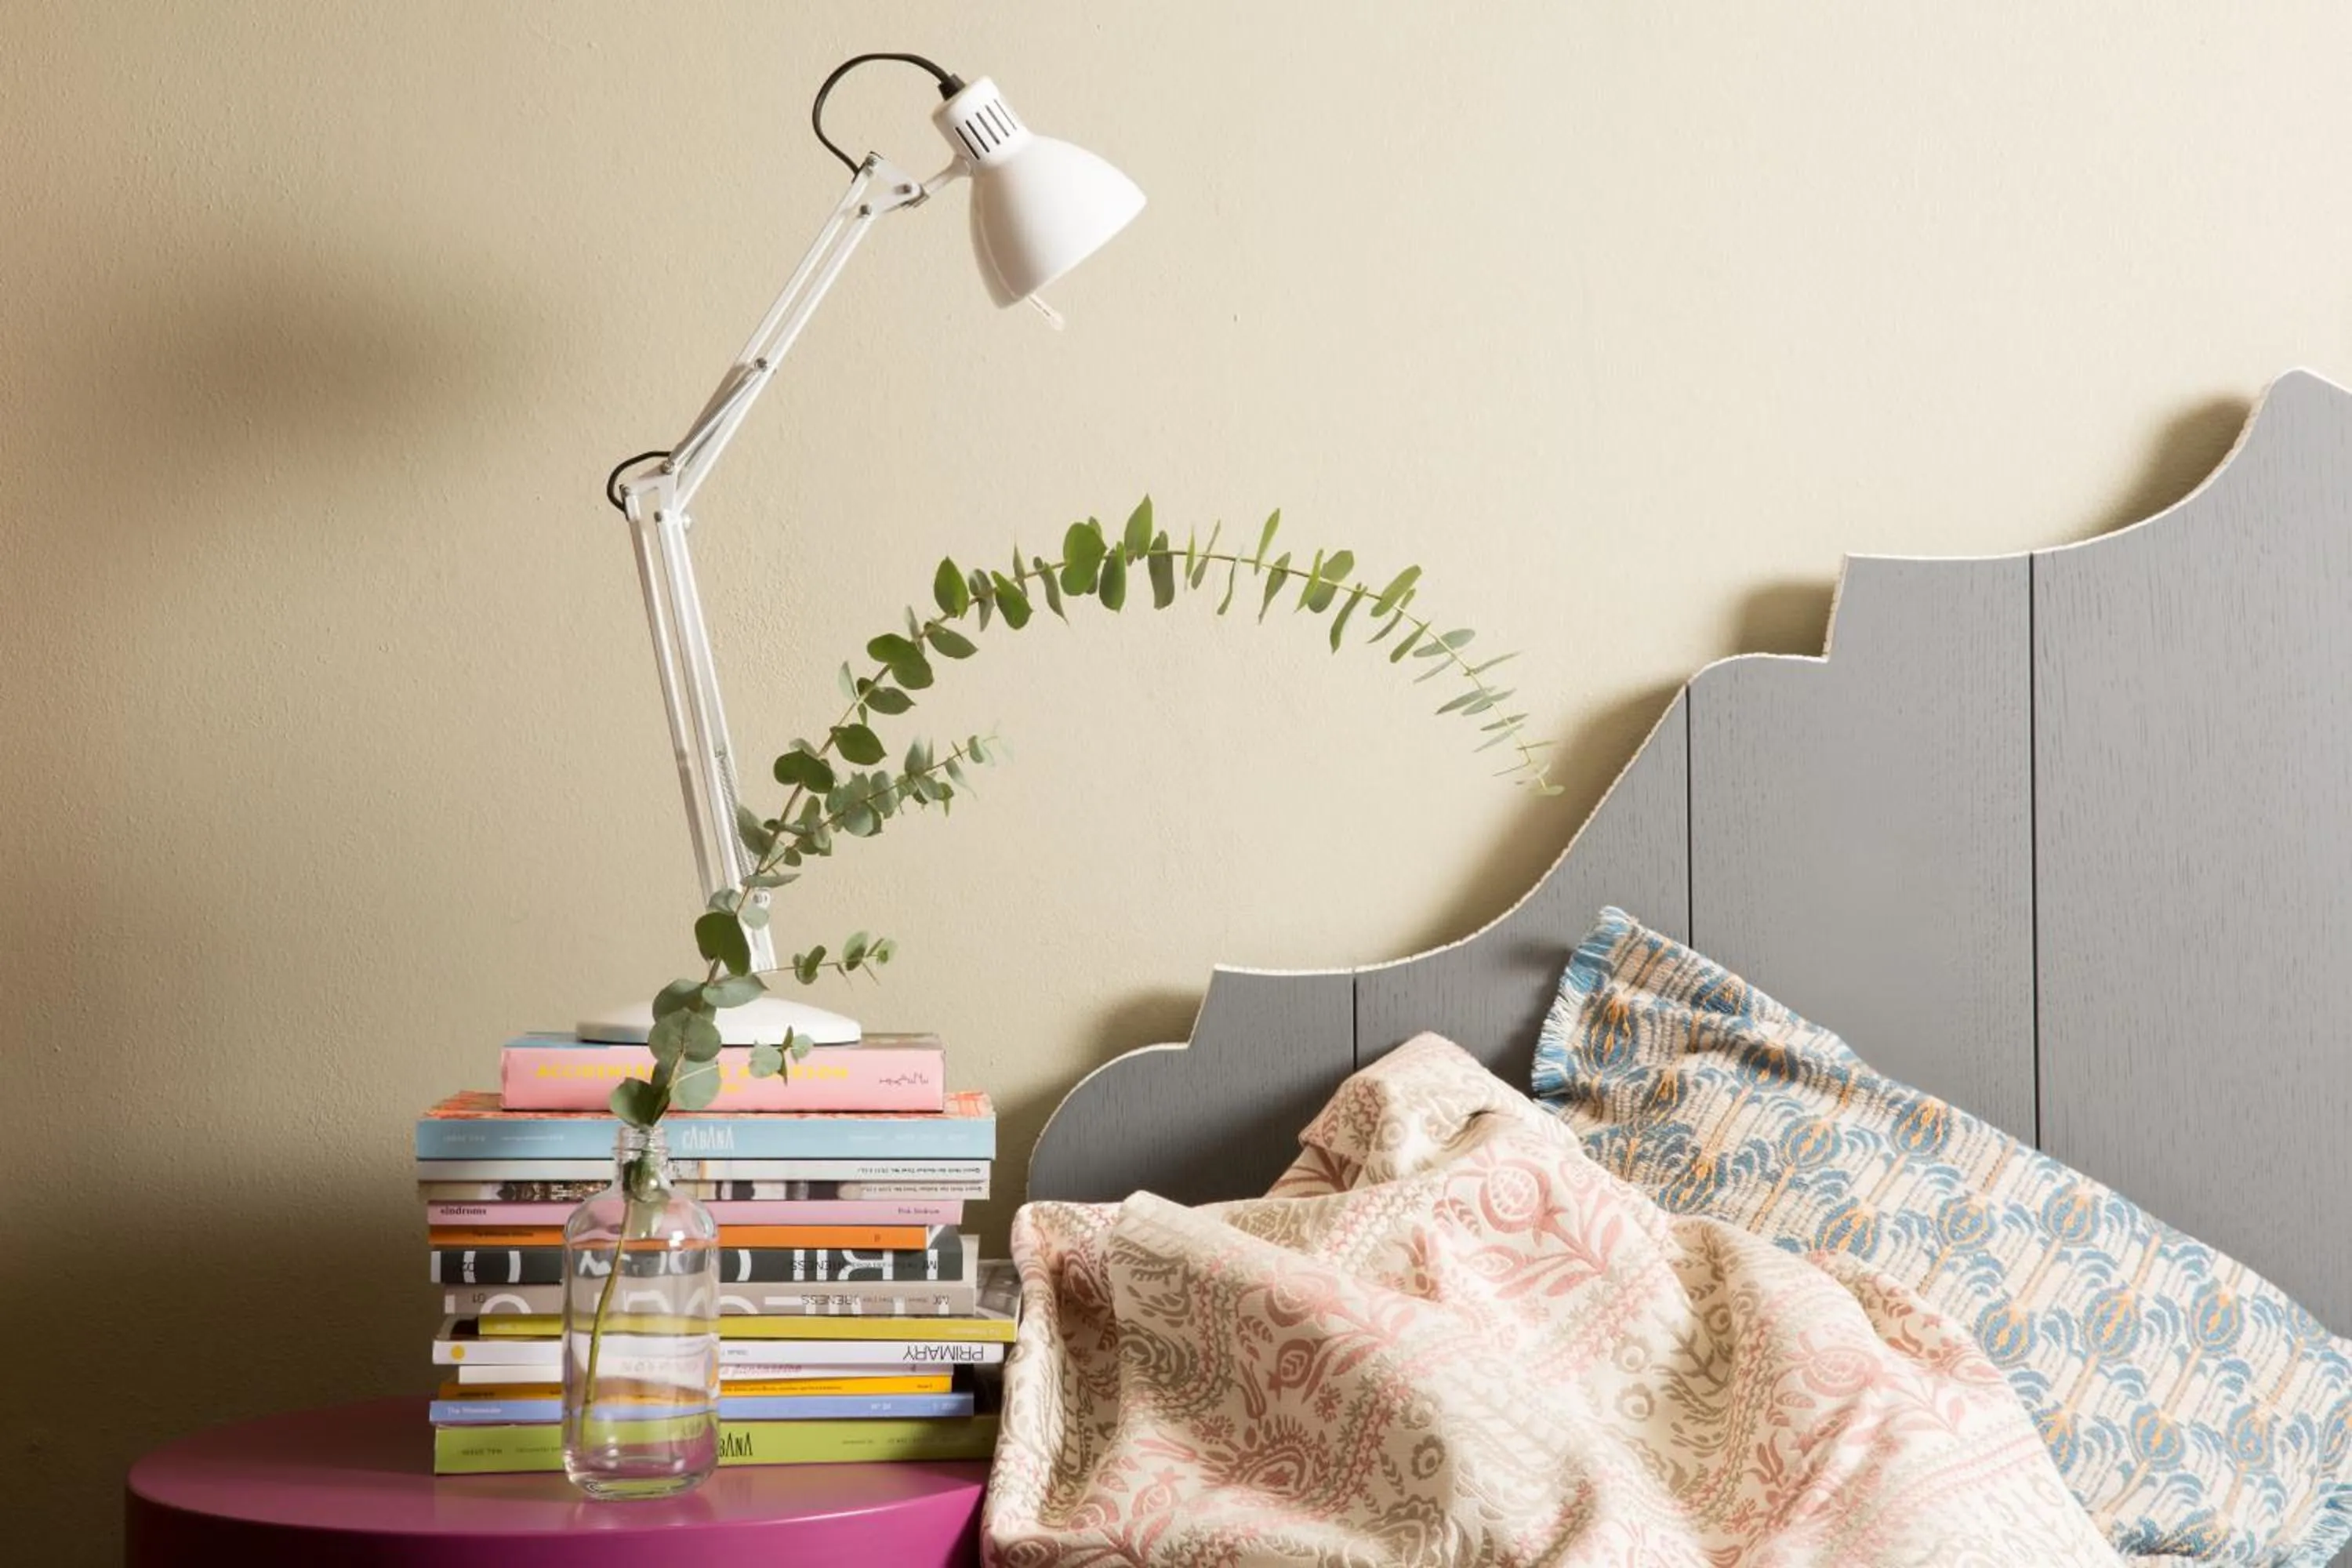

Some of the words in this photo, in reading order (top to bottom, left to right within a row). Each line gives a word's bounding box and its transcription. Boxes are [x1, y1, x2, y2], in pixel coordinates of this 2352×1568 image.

[681, 1123, 735, 1150] CABANA
[903, 1345, 984, 1361] PRIMARY
[719, 1432, 753, 1457] BANA
